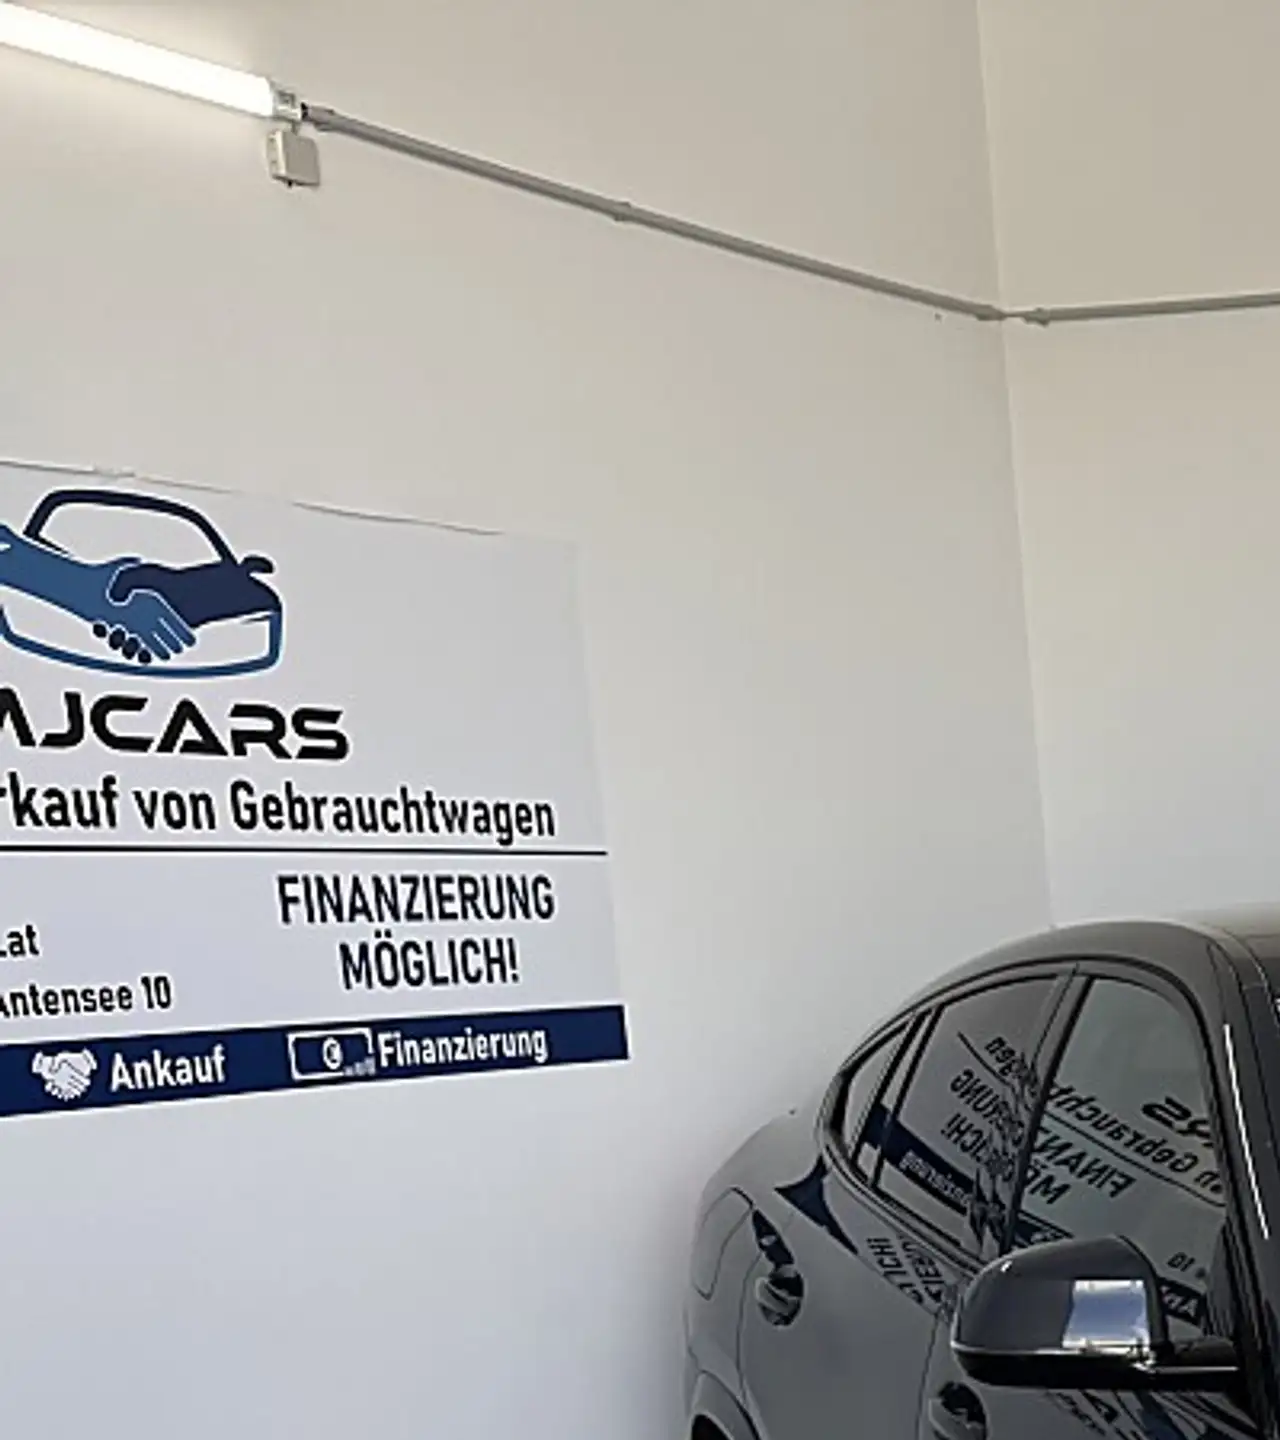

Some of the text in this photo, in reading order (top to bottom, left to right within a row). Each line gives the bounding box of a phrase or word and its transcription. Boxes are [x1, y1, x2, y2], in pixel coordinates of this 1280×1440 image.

[133, 790, 216, 830] von
[231, 780, 556, 846] Gebrauchtwagen
[278, 874, 554, 924] FINANZIERUNG
[339, 928, 519, 990] MÖGLICH!
[141, 976, 171, 1009] 10
[110, 1026, 548, 1092] Ankauf Finanzierung
